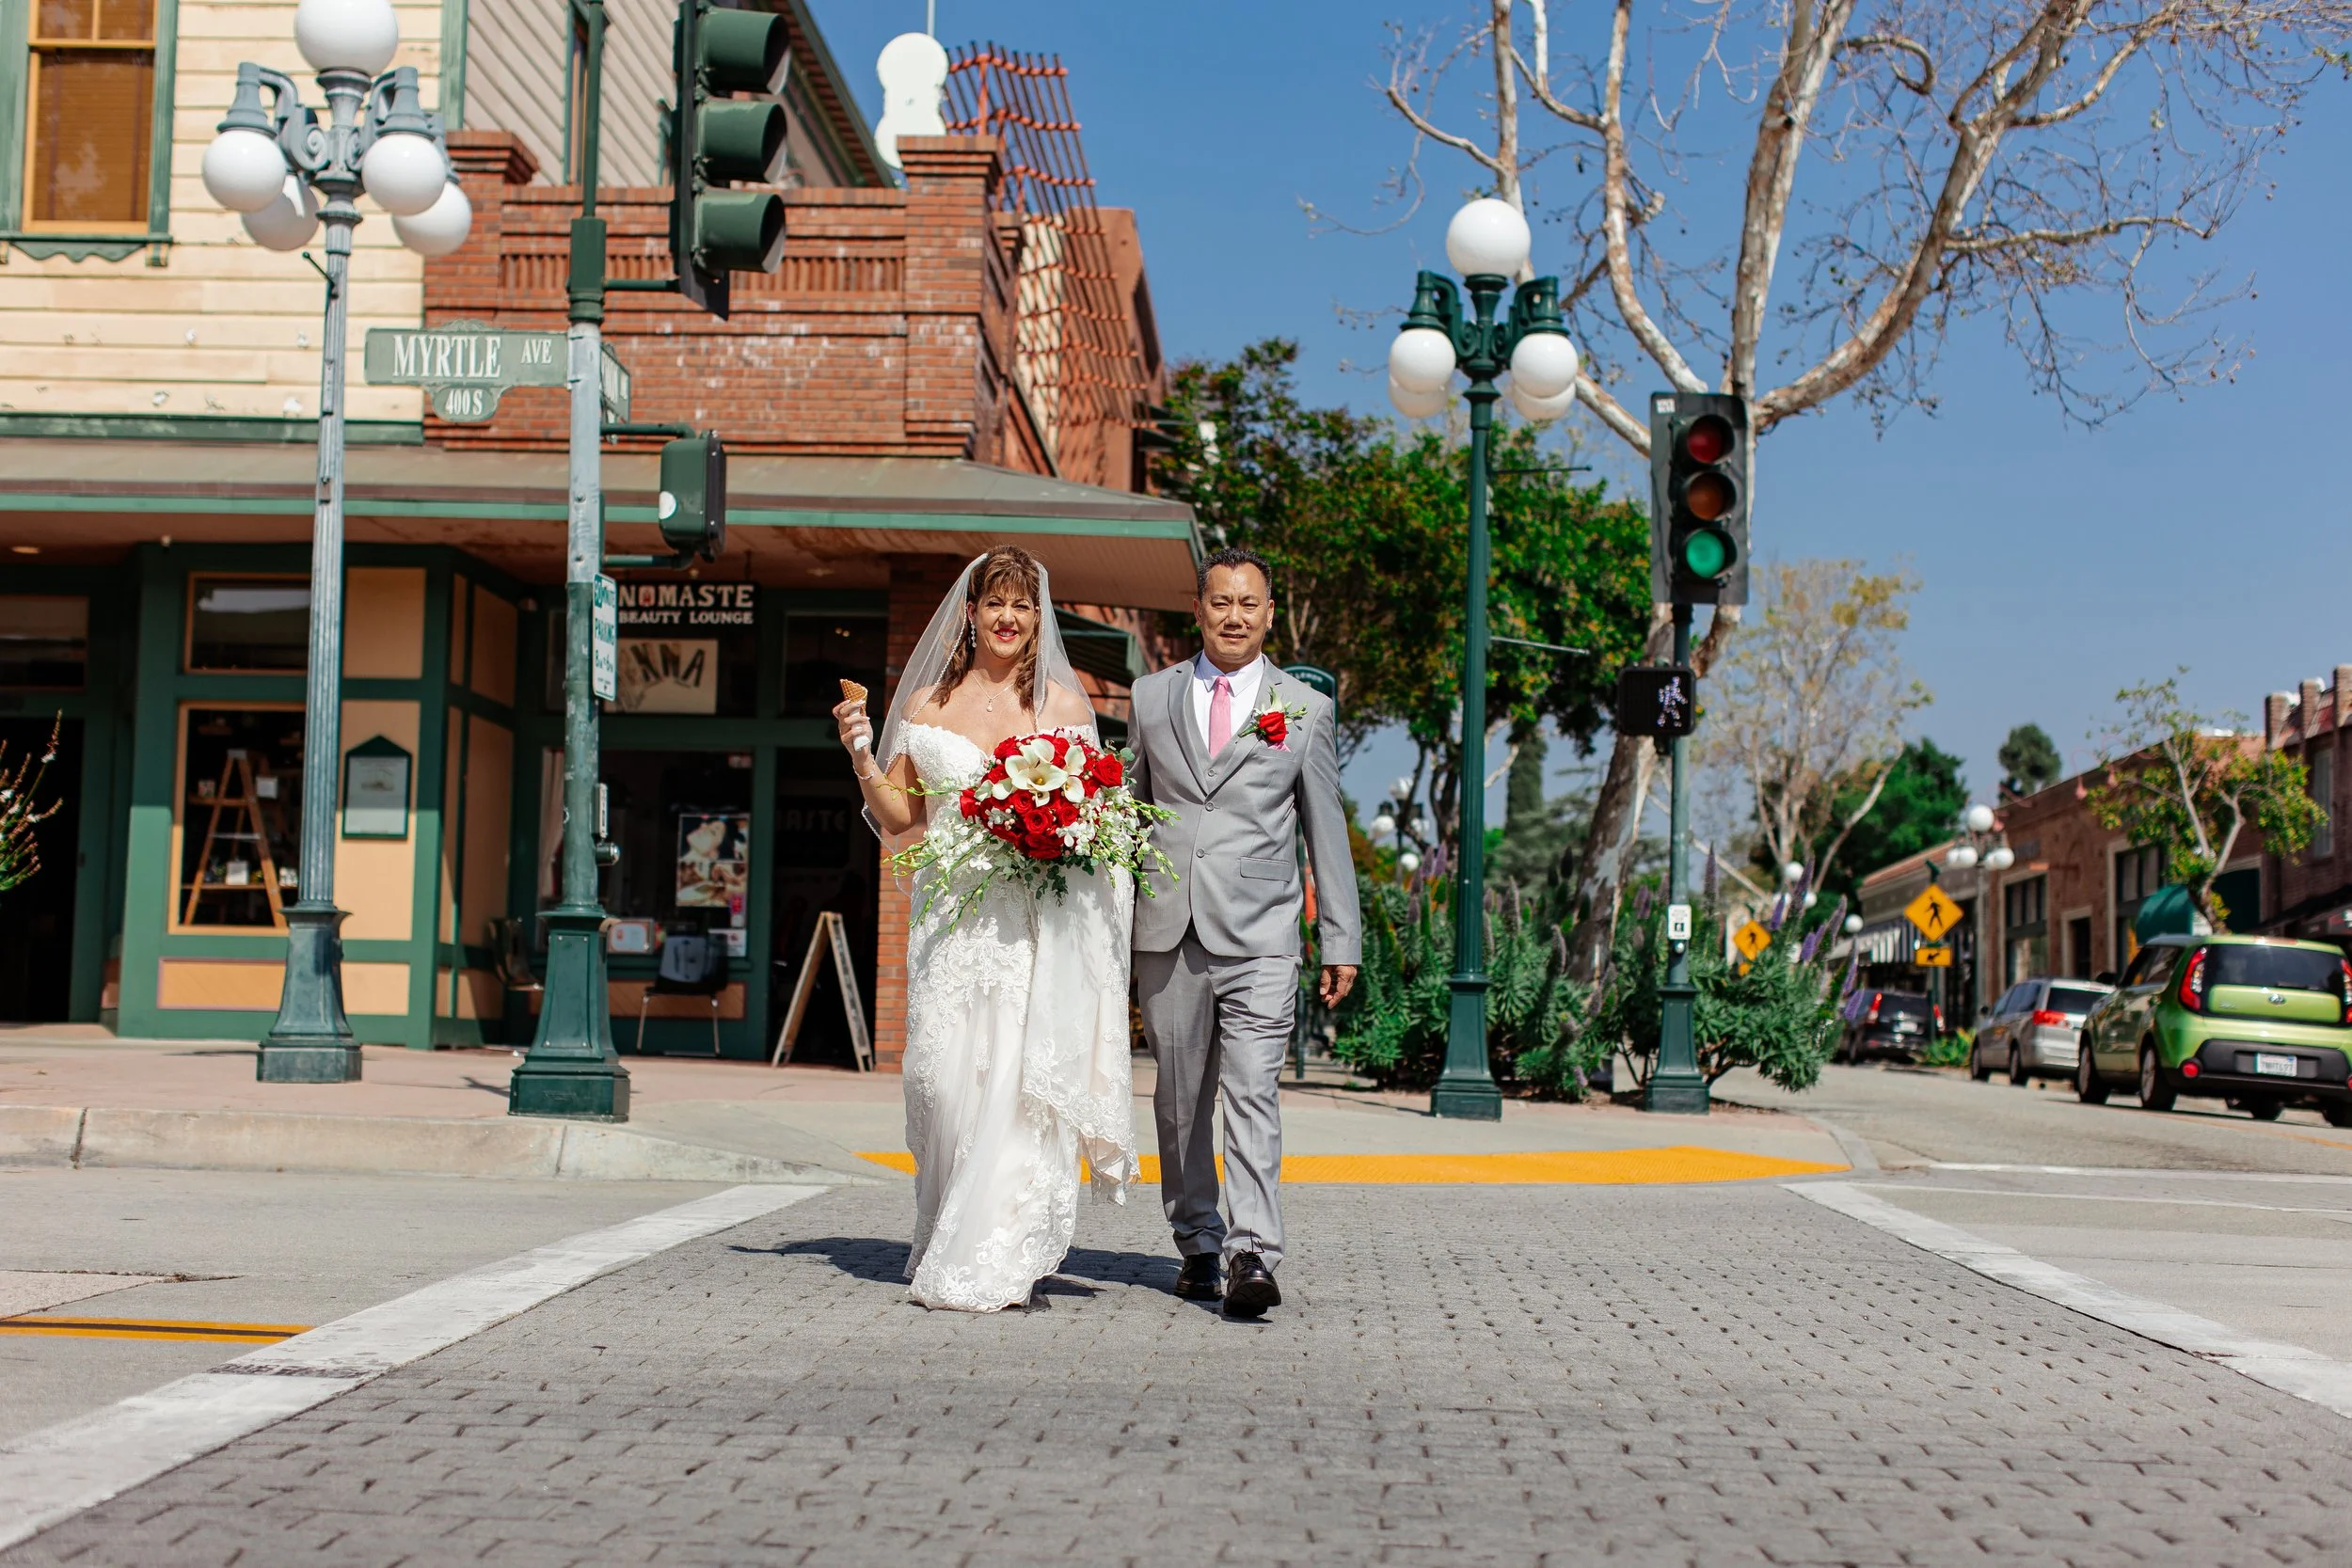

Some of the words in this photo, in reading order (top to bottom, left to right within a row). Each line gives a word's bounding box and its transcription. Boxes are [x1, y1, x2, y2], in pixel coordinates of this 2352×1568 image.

[392, 334, 501, 378] MYRTLE
[521, 339, 552, 364] AVE
[446, 389, 470, 416] 400
[472, 389, 483, 416] S
[618, 584, 755, 608] NOMASTE
[618, 611, 681, 625] BEAUTY
[690, 611, 754, 625] LOUNGE
